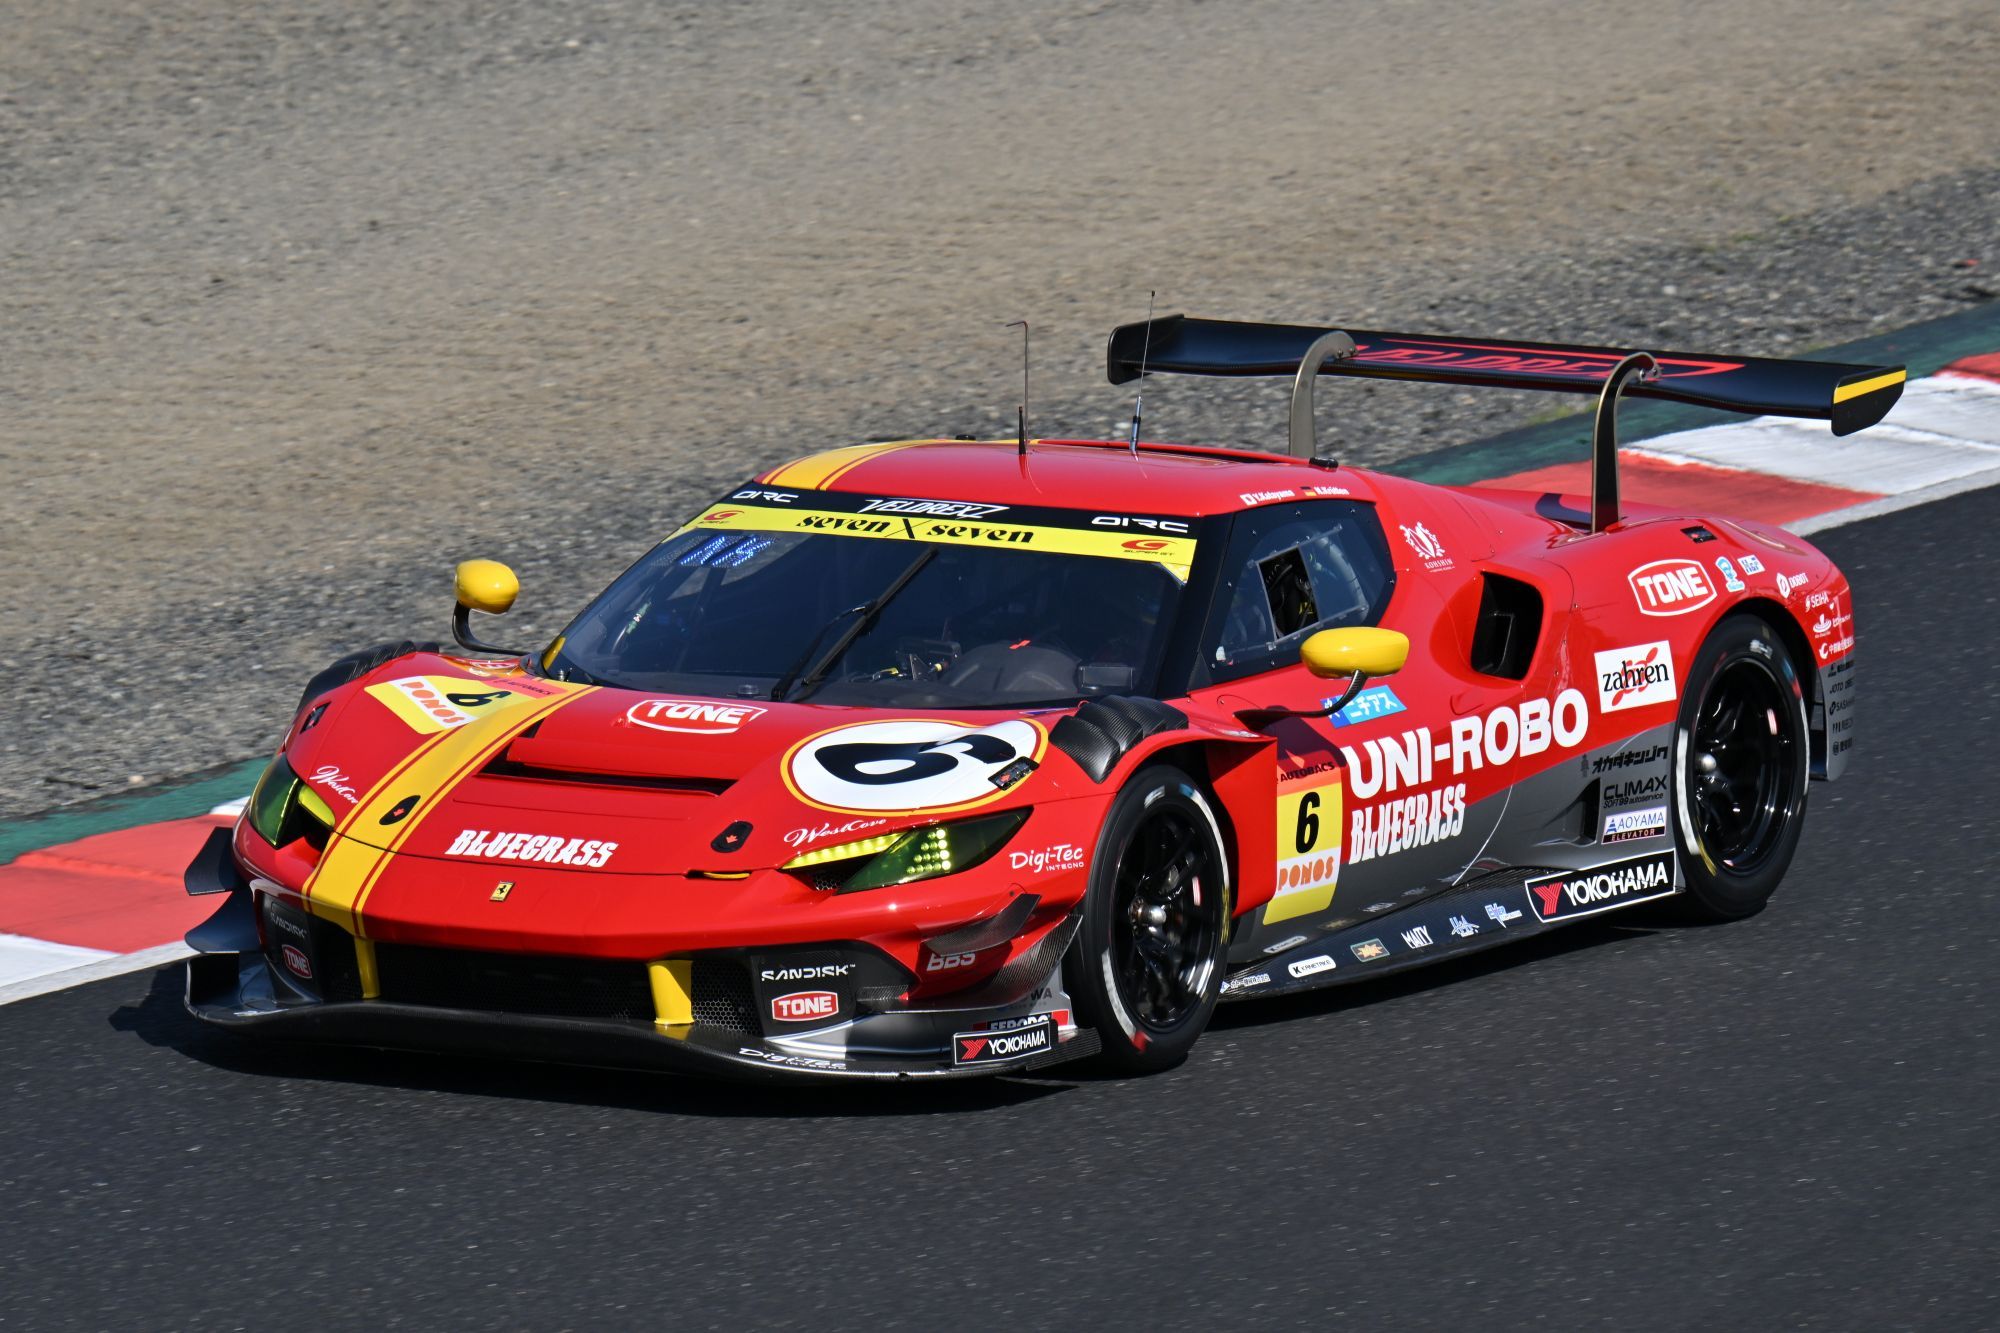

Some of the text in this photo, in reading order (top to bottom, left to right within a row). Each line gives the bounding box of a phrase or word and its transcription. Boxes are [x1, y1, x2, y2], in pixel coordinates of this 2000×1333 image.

[796, 515, 891, 533] seven
[926, 525, 1034, 544] seven
[1636, 566, 1708, 607] TONE
[1602, 660, 1670, 692] zahren
[401, 681, 466, 724] PONOS
[446, 690, 512, 707] 6
[648, 700, 748, 725] TONE
[1339, 688, 1589, 799] UNI-ROBO
[814, 734, 1016, 786] 6
[1280, 761, 1335, 782] AUTOBACS
[1603, 774, 1667, 801] CLIMAX
[1295, 791, 1320, 854] 6
[1349, 783, 1467, 865] BLUEGRASS
[1611, 828, 1655, 841] ELEVATOR
[1617, 812, 1664, 830] AOYAMA
[444, 829, 618, 868] BLUEGRASS
[1009, 843, 1083, 873] Digi-Tec
[1278, 856, 1334, 892] PONOS
[1563, 861, 1668, 907] YOKOHAMA
[284, 949, 310, 975] TONE
[761, 965, 849, 981] SANDISK
[778, 996, 833, 1017] TONE
[987, 1029, 1046, 1056] YOKOHAMA
